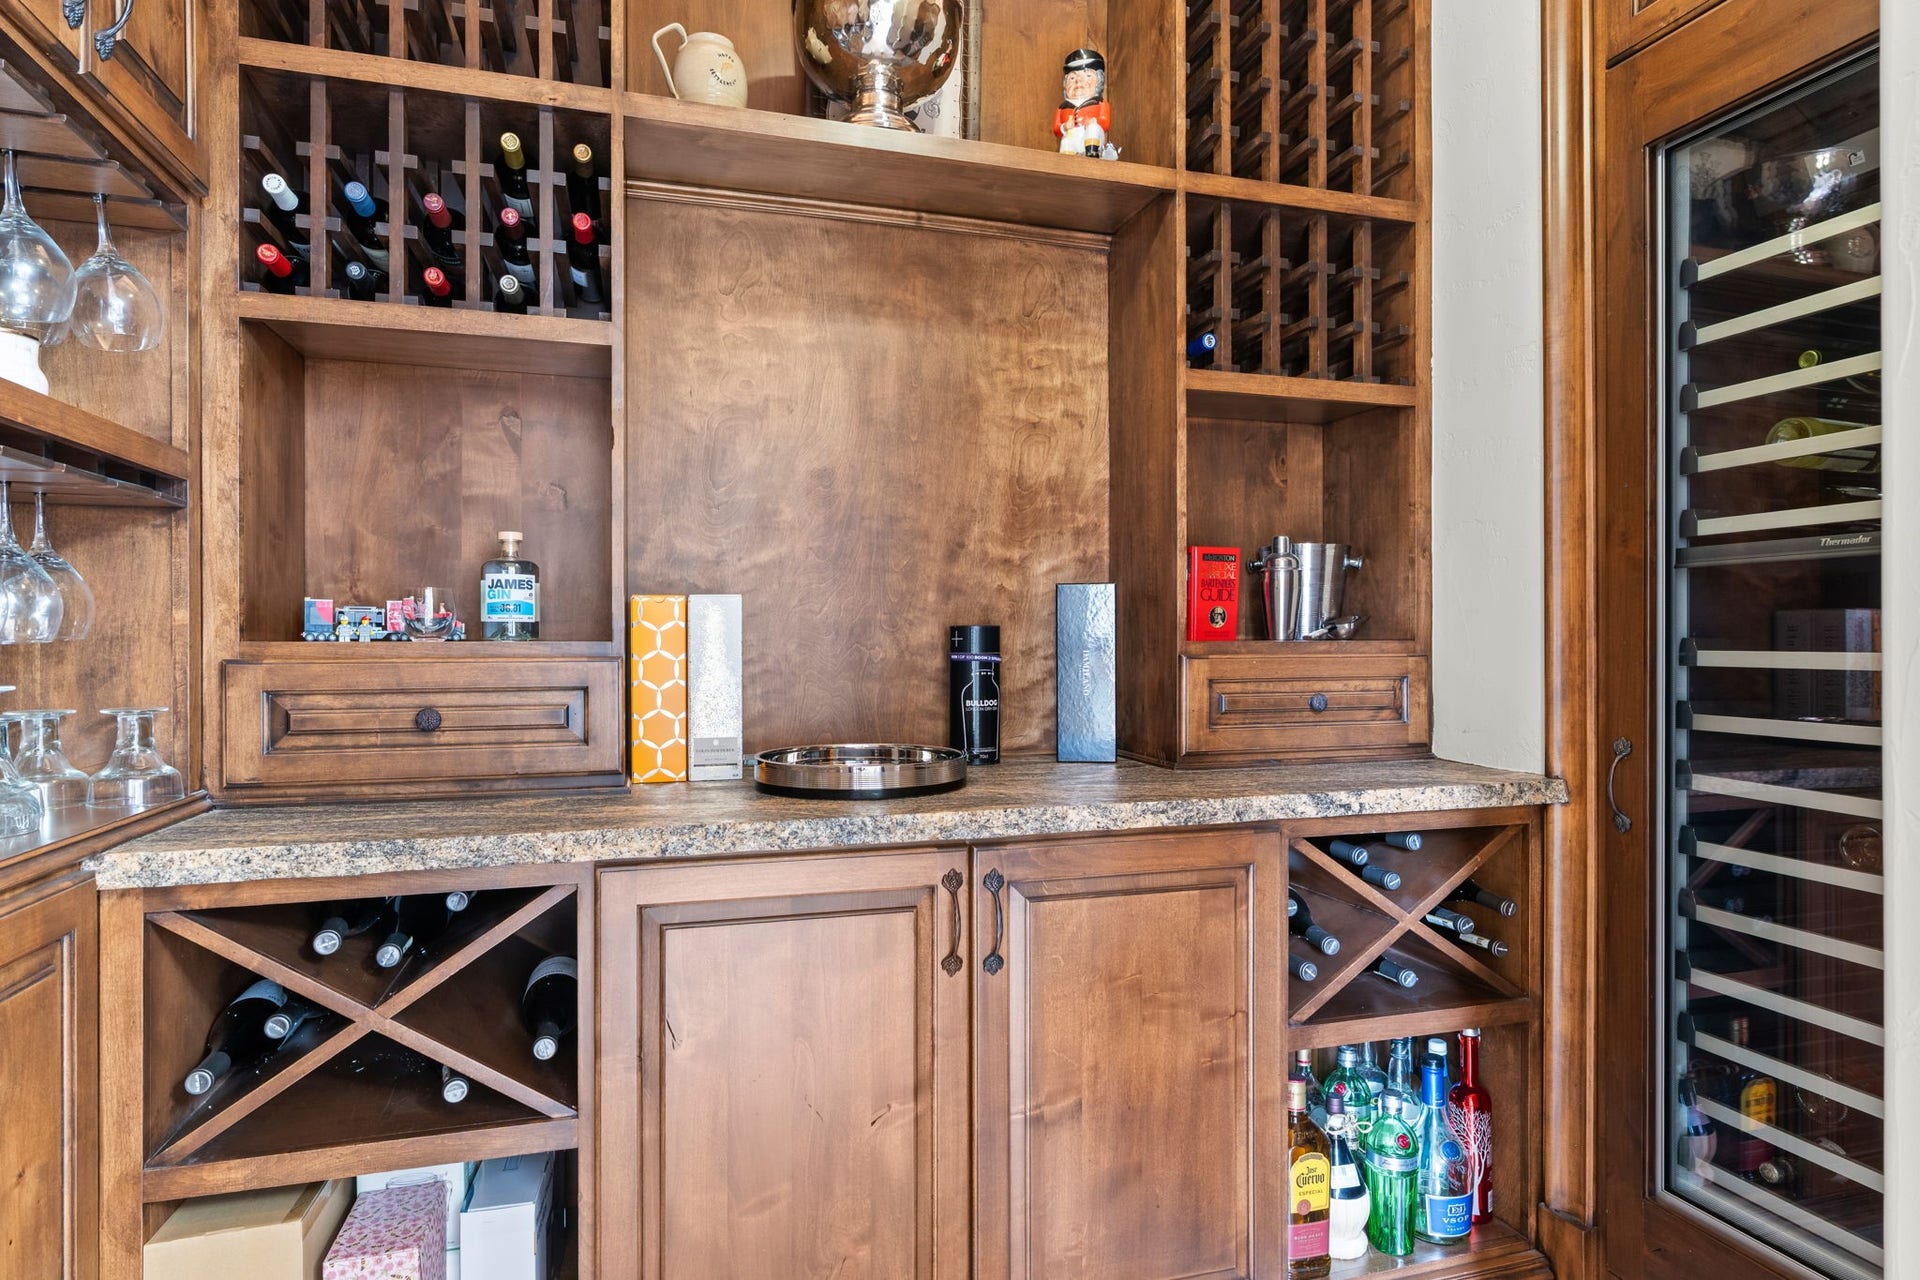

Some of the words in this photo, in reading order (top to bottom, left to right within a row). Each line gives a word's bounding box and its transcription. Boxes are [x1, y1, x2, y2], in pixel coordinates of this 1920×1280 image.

[1820, 534, 1872, 547] Thermador
[488, 579, 534, 590] JAMES
[487, 589, 511, 600] GIN
[1200, 588, 1235, 602] GUIDE
[965, 699, 998, 707] BULLDOG
[1296, 1173, 1325, 1188] Cuervo
[1441, 1214, 1470, 1224] VSOP
